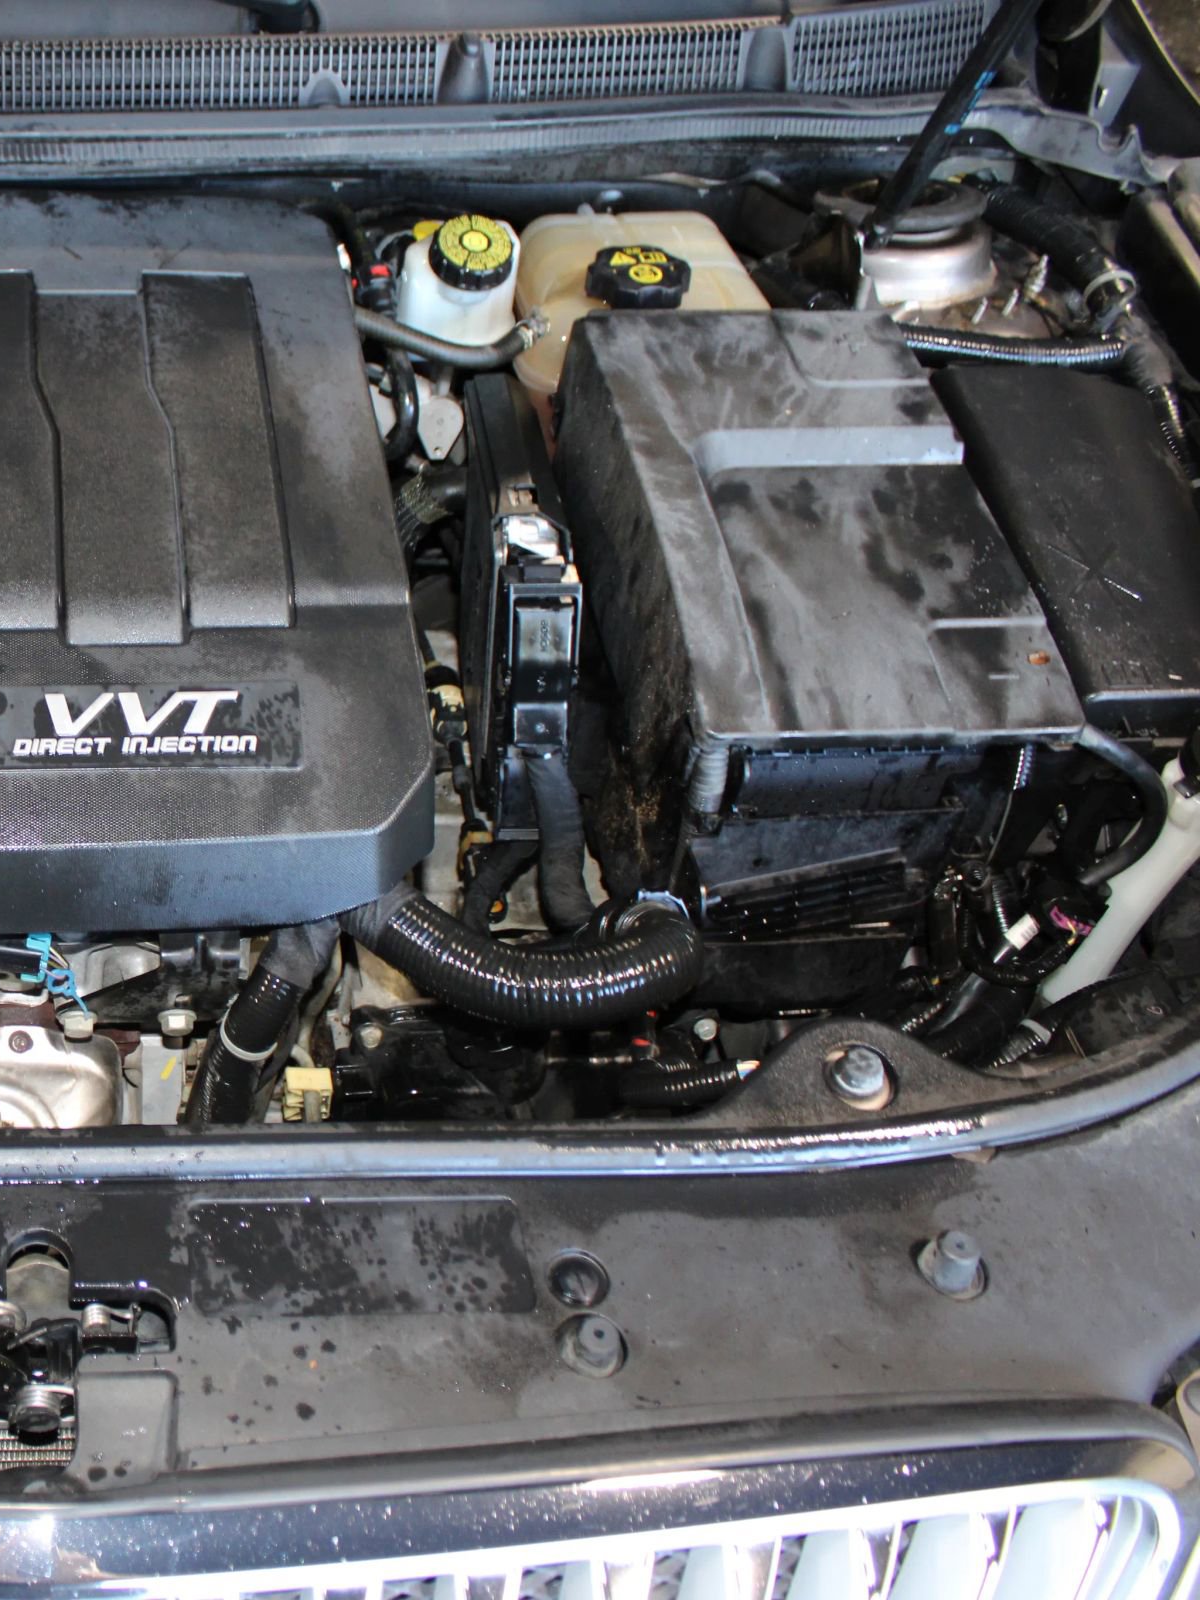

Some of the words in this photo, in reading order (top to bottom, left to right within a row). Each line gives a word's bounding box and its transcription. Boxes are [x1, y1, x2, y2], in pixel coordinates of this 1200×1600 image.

[45, 690, 239, 736] VVT
[12, 737, 112, 758] DIRECT
[121, 735, 257, 756] INJECTION
